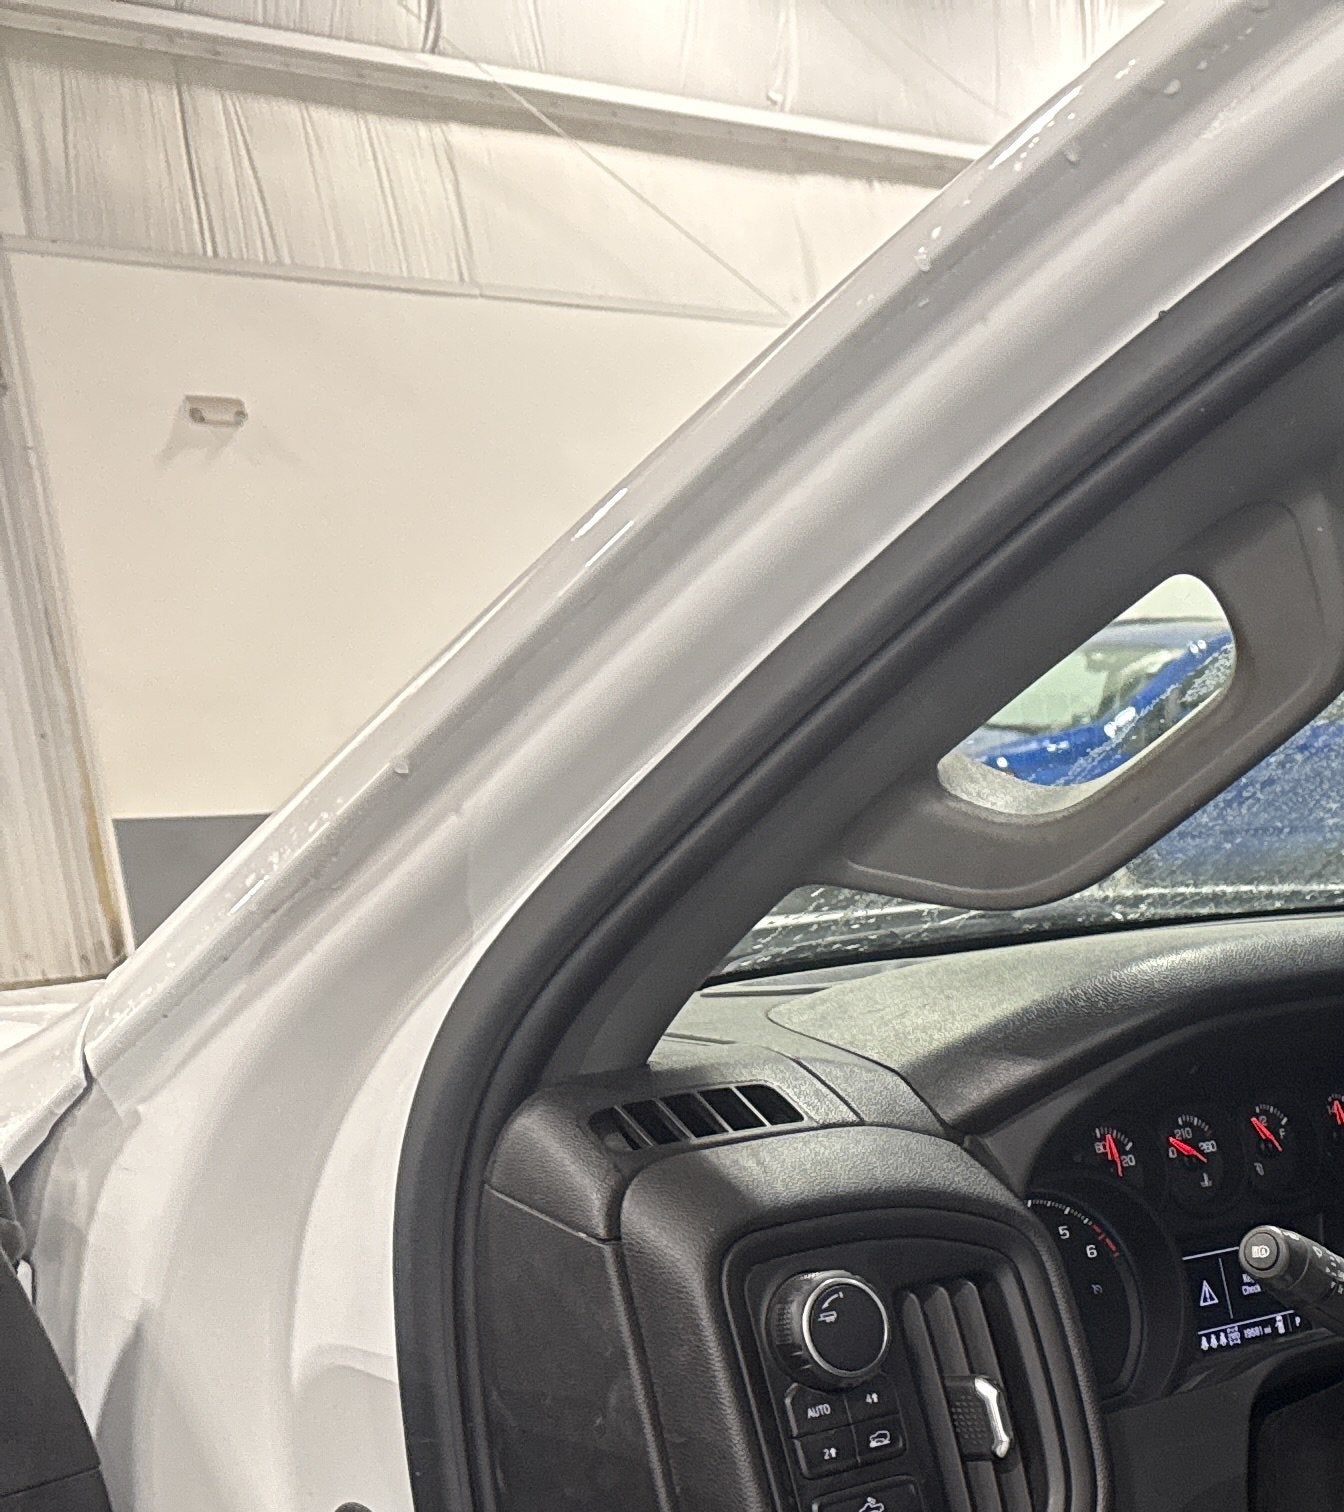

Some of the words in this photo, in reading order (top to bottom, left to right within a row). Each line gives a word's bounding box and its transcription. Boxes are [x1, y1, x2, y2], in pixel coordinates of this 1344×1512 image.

[1174, 1127, 1193, 1141] 210
[1057, 1225, 1070, 1240] 5
[1085, 1244, 1098, 1258] 6
[806, 1403, 832, 1420] AUTO
